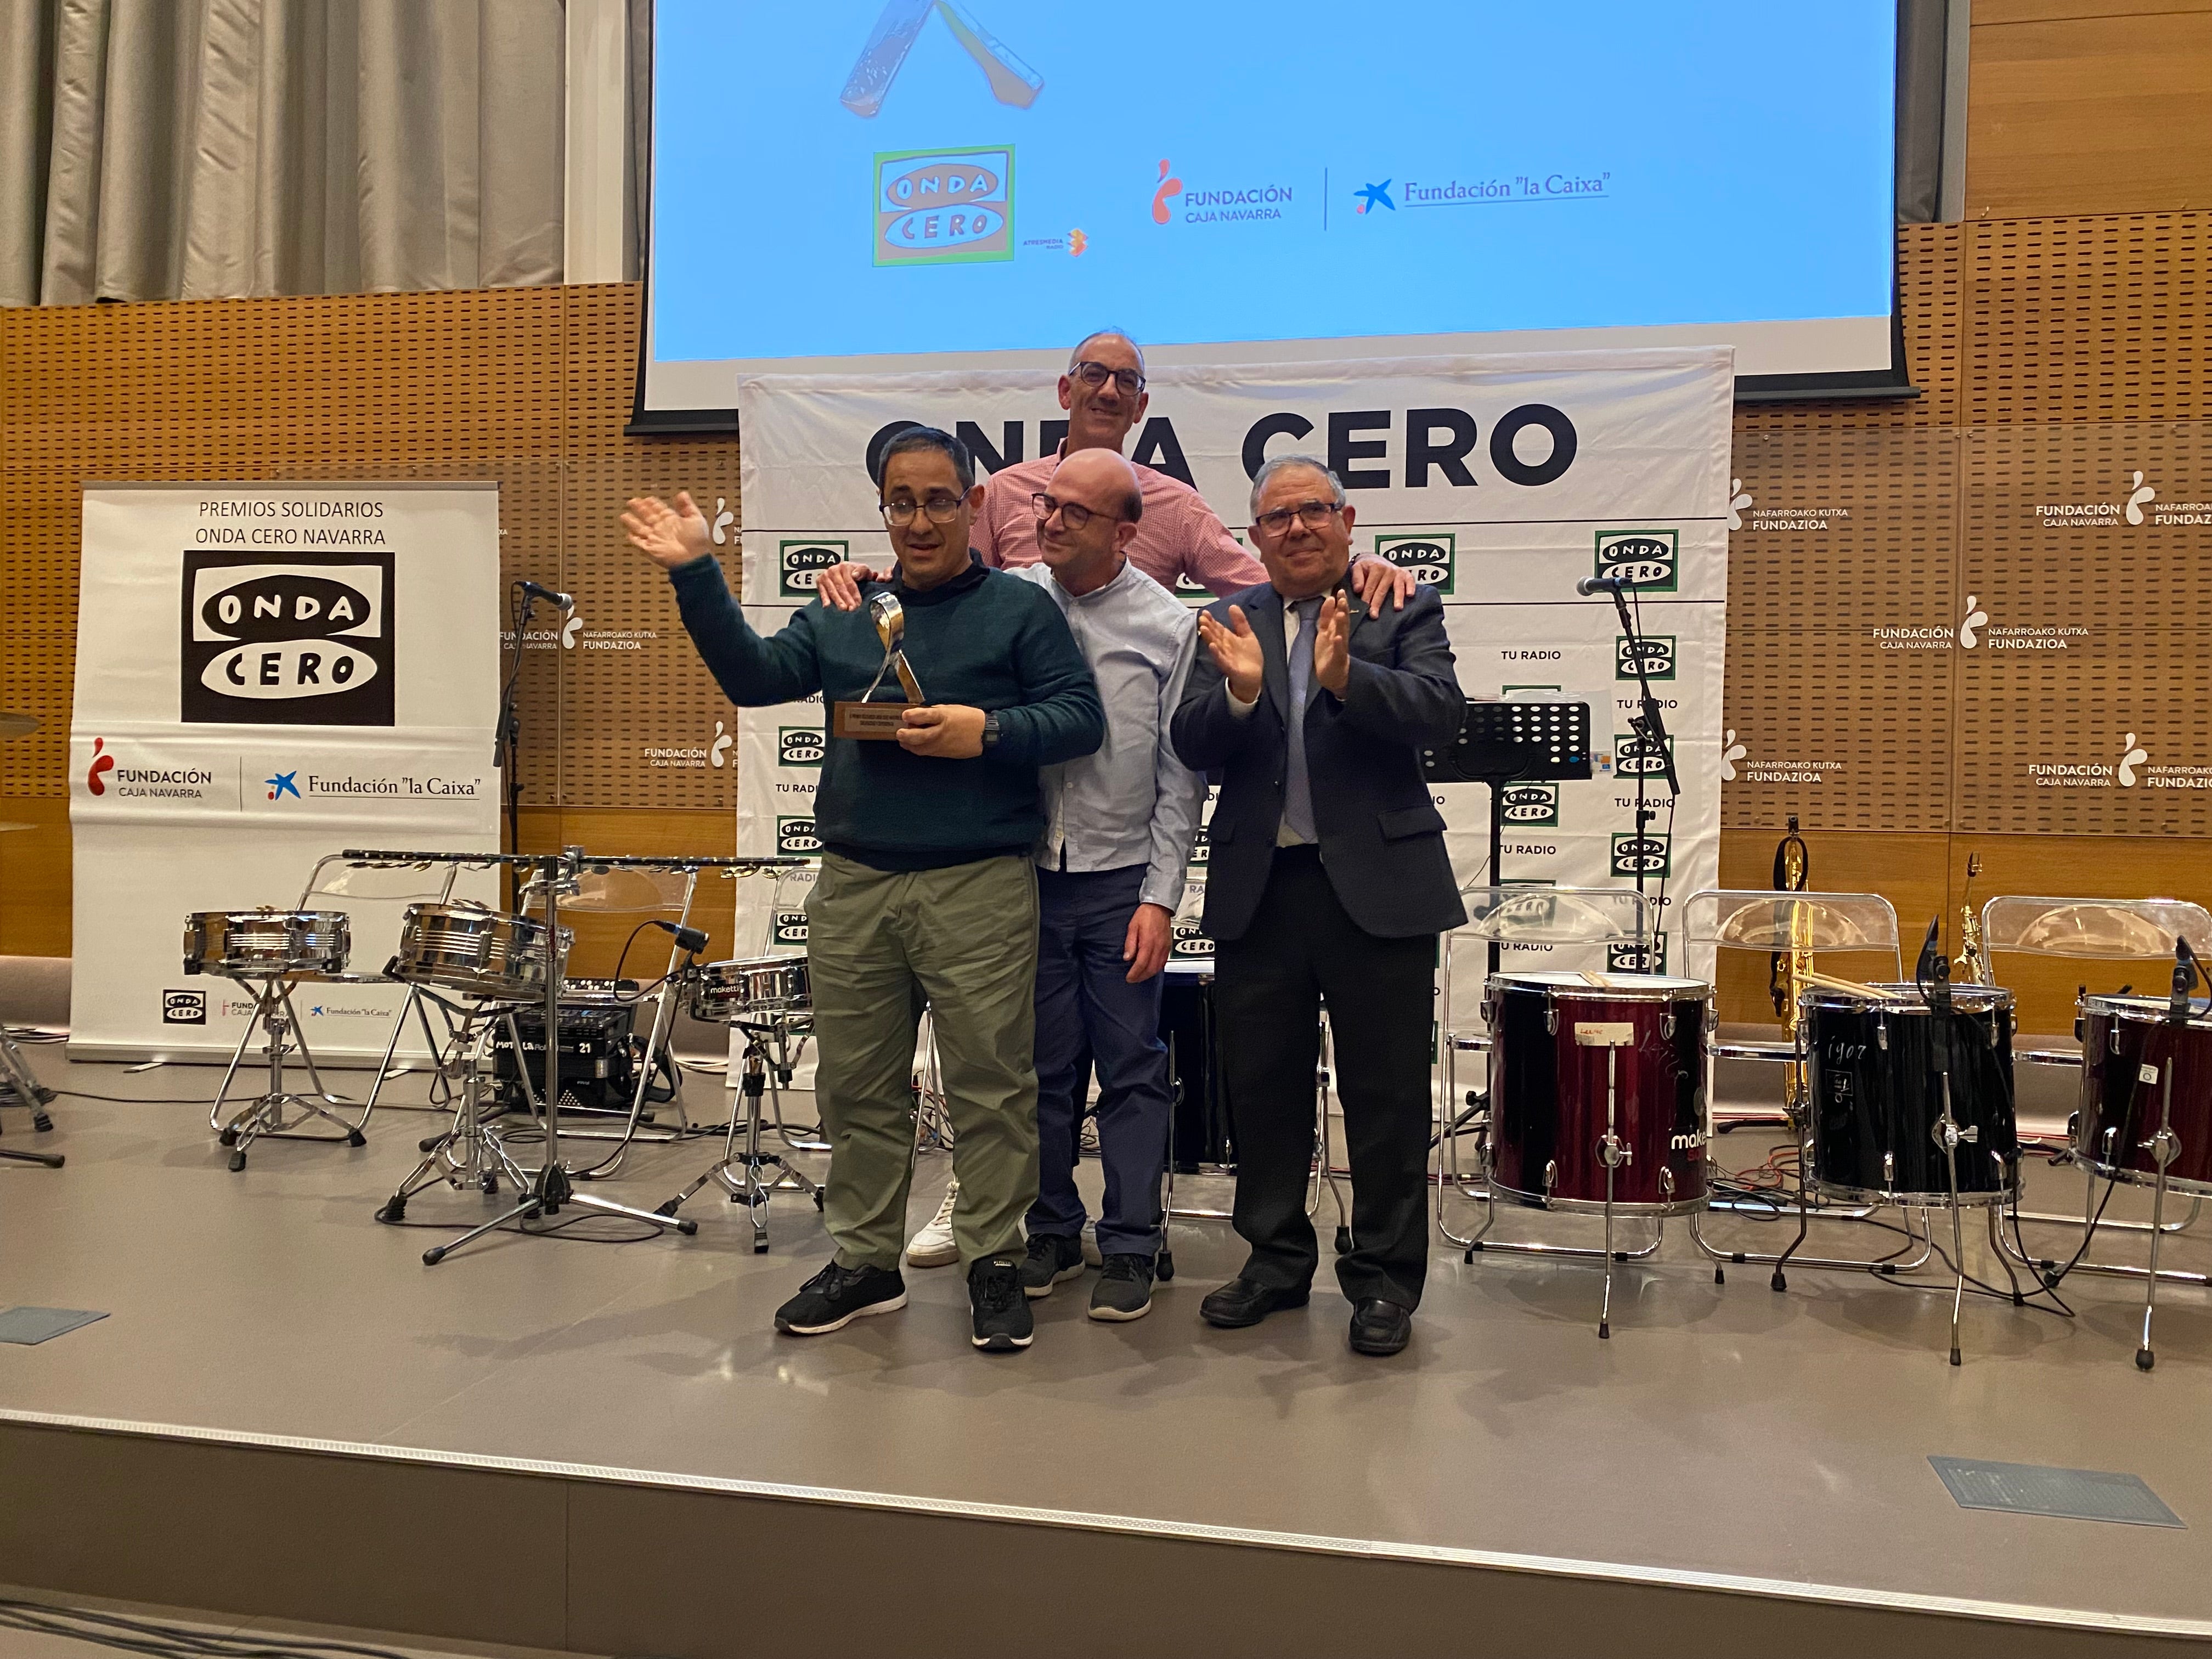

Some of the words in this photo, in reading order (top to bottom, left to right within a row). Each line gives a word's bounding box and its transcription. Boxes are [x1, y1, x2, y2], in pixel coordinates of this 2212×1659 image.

[896, 173, 988, 200] ONDA
[1404, 179, 1511, 201] Fundación
[1185, 184, 1293, 207] FUNDACIÓN
[1186, 211, 1217, 223] CAJA
[1220, 208, 1282, 222] NAVARRA
[902, 214, 988, 240] CERO
[199, 501, 275, 517] PREMIOS
[281, 501, 383, 517] SOLIDARIOS
[1753, 509, 1817, 517] NAFARROAKO
[1819, 509, 1848, 517] KUTXA
[2036, 502, 2121, 516] FUNDACIÓN
[1753, 520, 1828, 531] FUNDAZIOA
[2043, 518, 2068, 527] CAJA
[2070, 518, 2119, 526] NAVARRA
[196, 528, 246, 543] ONDA
[251, 528, 297, 544] CERO
[303, 529, 386, 545] NAVARRA
[1388, 549, 1440, 561] ONDA
[1609, 544, 1662, 557] ONDA
[791, 554, 836, 565] ONDA
[1611, 566, 1662, 578] CERO
[218, 594, 354, 624] ONDA
[1873, 625, 1954, 639] FUNDACIÓN
[1988, 628, 2055, 636] NAFARROAKO
[2058, 628, 2089, 636] KUTXA
[583, 641, 642, 650] FUNDAZIOA
[1880, 641, 1905, 650] CAJA
[1906, 641, 1953, 650] NAVARRA
[1988, 639, 2068, 650] FUNDAZIOA
[1501, 651, 1517, 659] TU
[1521, 651, 1561, 659] RADIO
[225, 652, 354, 686] CERO
[1628, 661, 1664, 670] CRO
[1617, 699, 1633, 708] TU
[644, 747, 707, 758] FUNDACIÓN
[789, 750, 819, 758] CERO
[1747, 761, 1811, 769] NAFARROAKO
[2028, 763, 2113, 776] FUNDACIÓN
[117, 768, 212, 784] FUNDACIÓN
[1747, 771, 1822, 782] FUNDAZIOA
[308, 775, 398, 793] Fundación
[776, 784, 789, 792] TU
[2063, 778, 2112, 787] NAVARRA
[119, 787, 147, 797] CAJA
[149, 788, 202, 798] NAVARRA
[1615, 798, 1630, 807] TU
[1510, 808, 1548, 816] CERO
[787, 839, 817, 847] CERO
[1516, 845, 1556, 854] RADIO
[1181, 942, 1214, 951] CERO
[579, 1043, 591, 1053] 21
